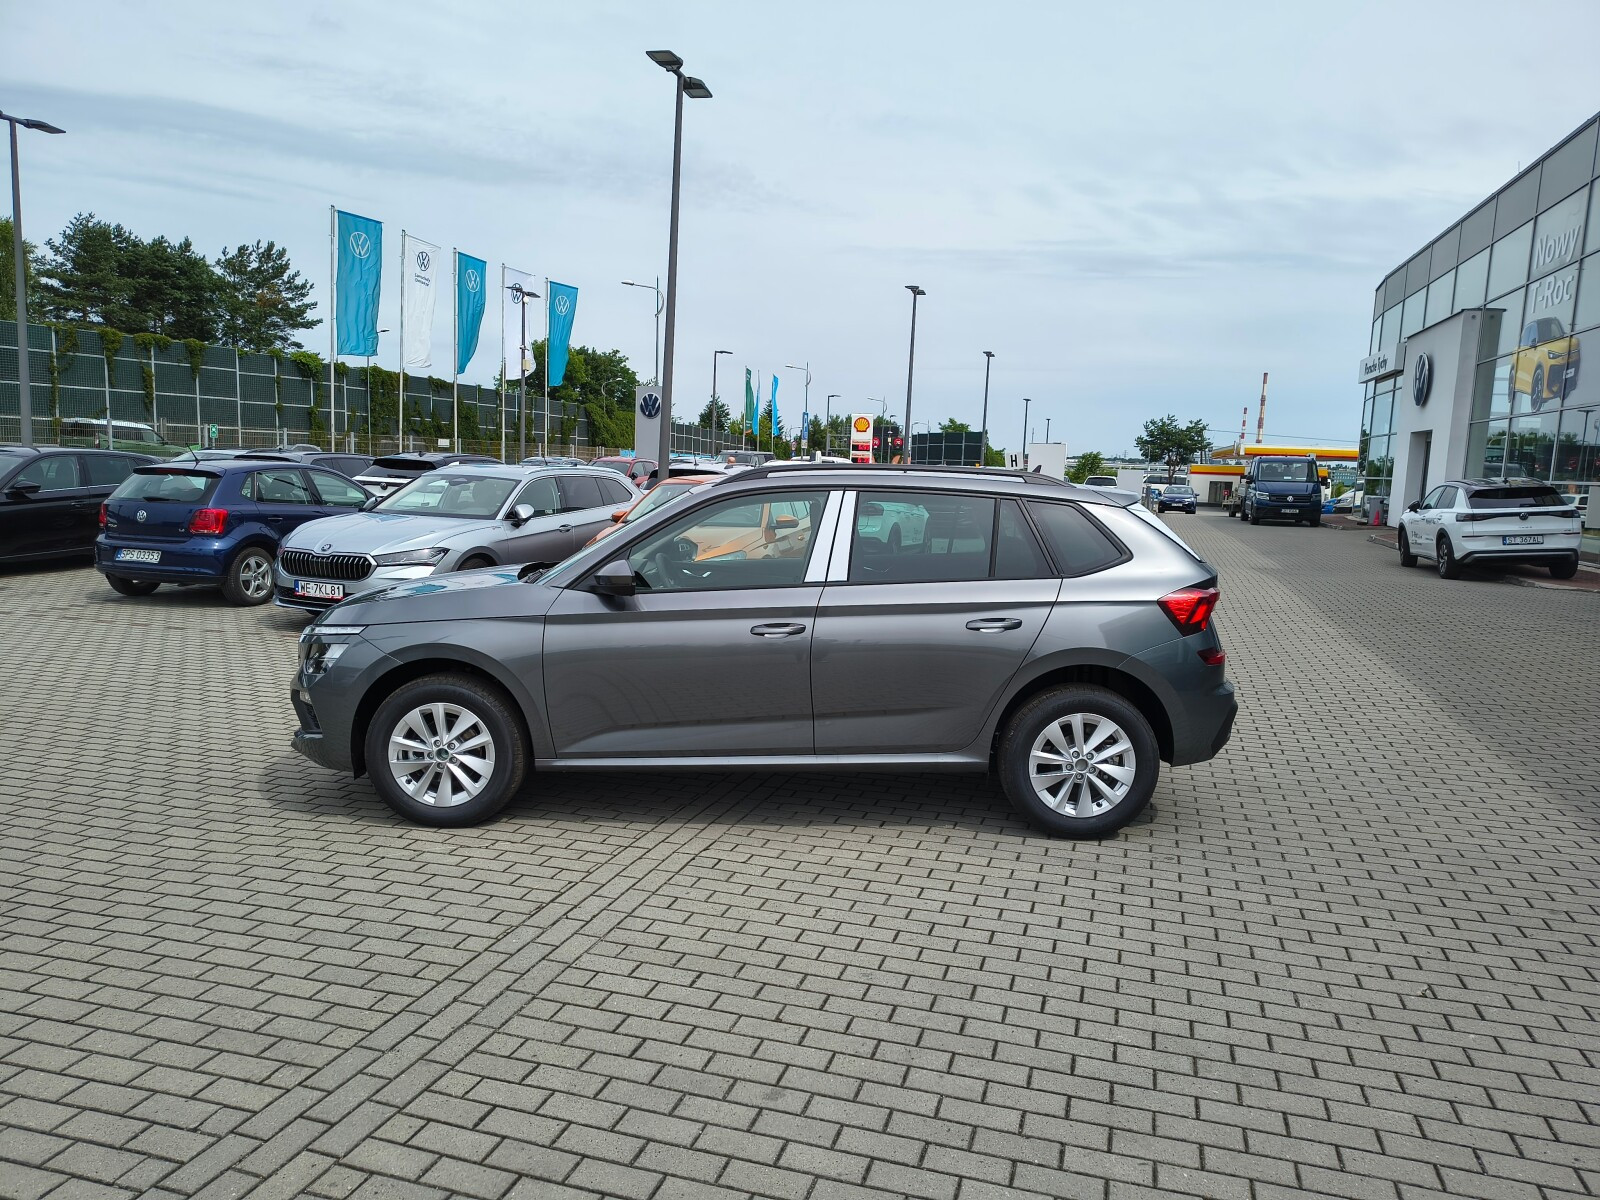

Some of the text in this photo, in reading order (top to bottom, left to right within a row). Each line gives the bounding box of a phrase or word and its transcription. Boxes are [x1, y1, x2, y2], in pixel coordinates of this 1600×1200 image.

[1534, 225, 1581, 270] Nowy
[1531, 275, 1574, 313] T-Roc
[1507, 535, 1541, 544] ST 367AL
[121, 549, 161, 560] SPS 03353
[300, 582, 311, 593] WE
[313, 583, 340, 596] 7KL81
